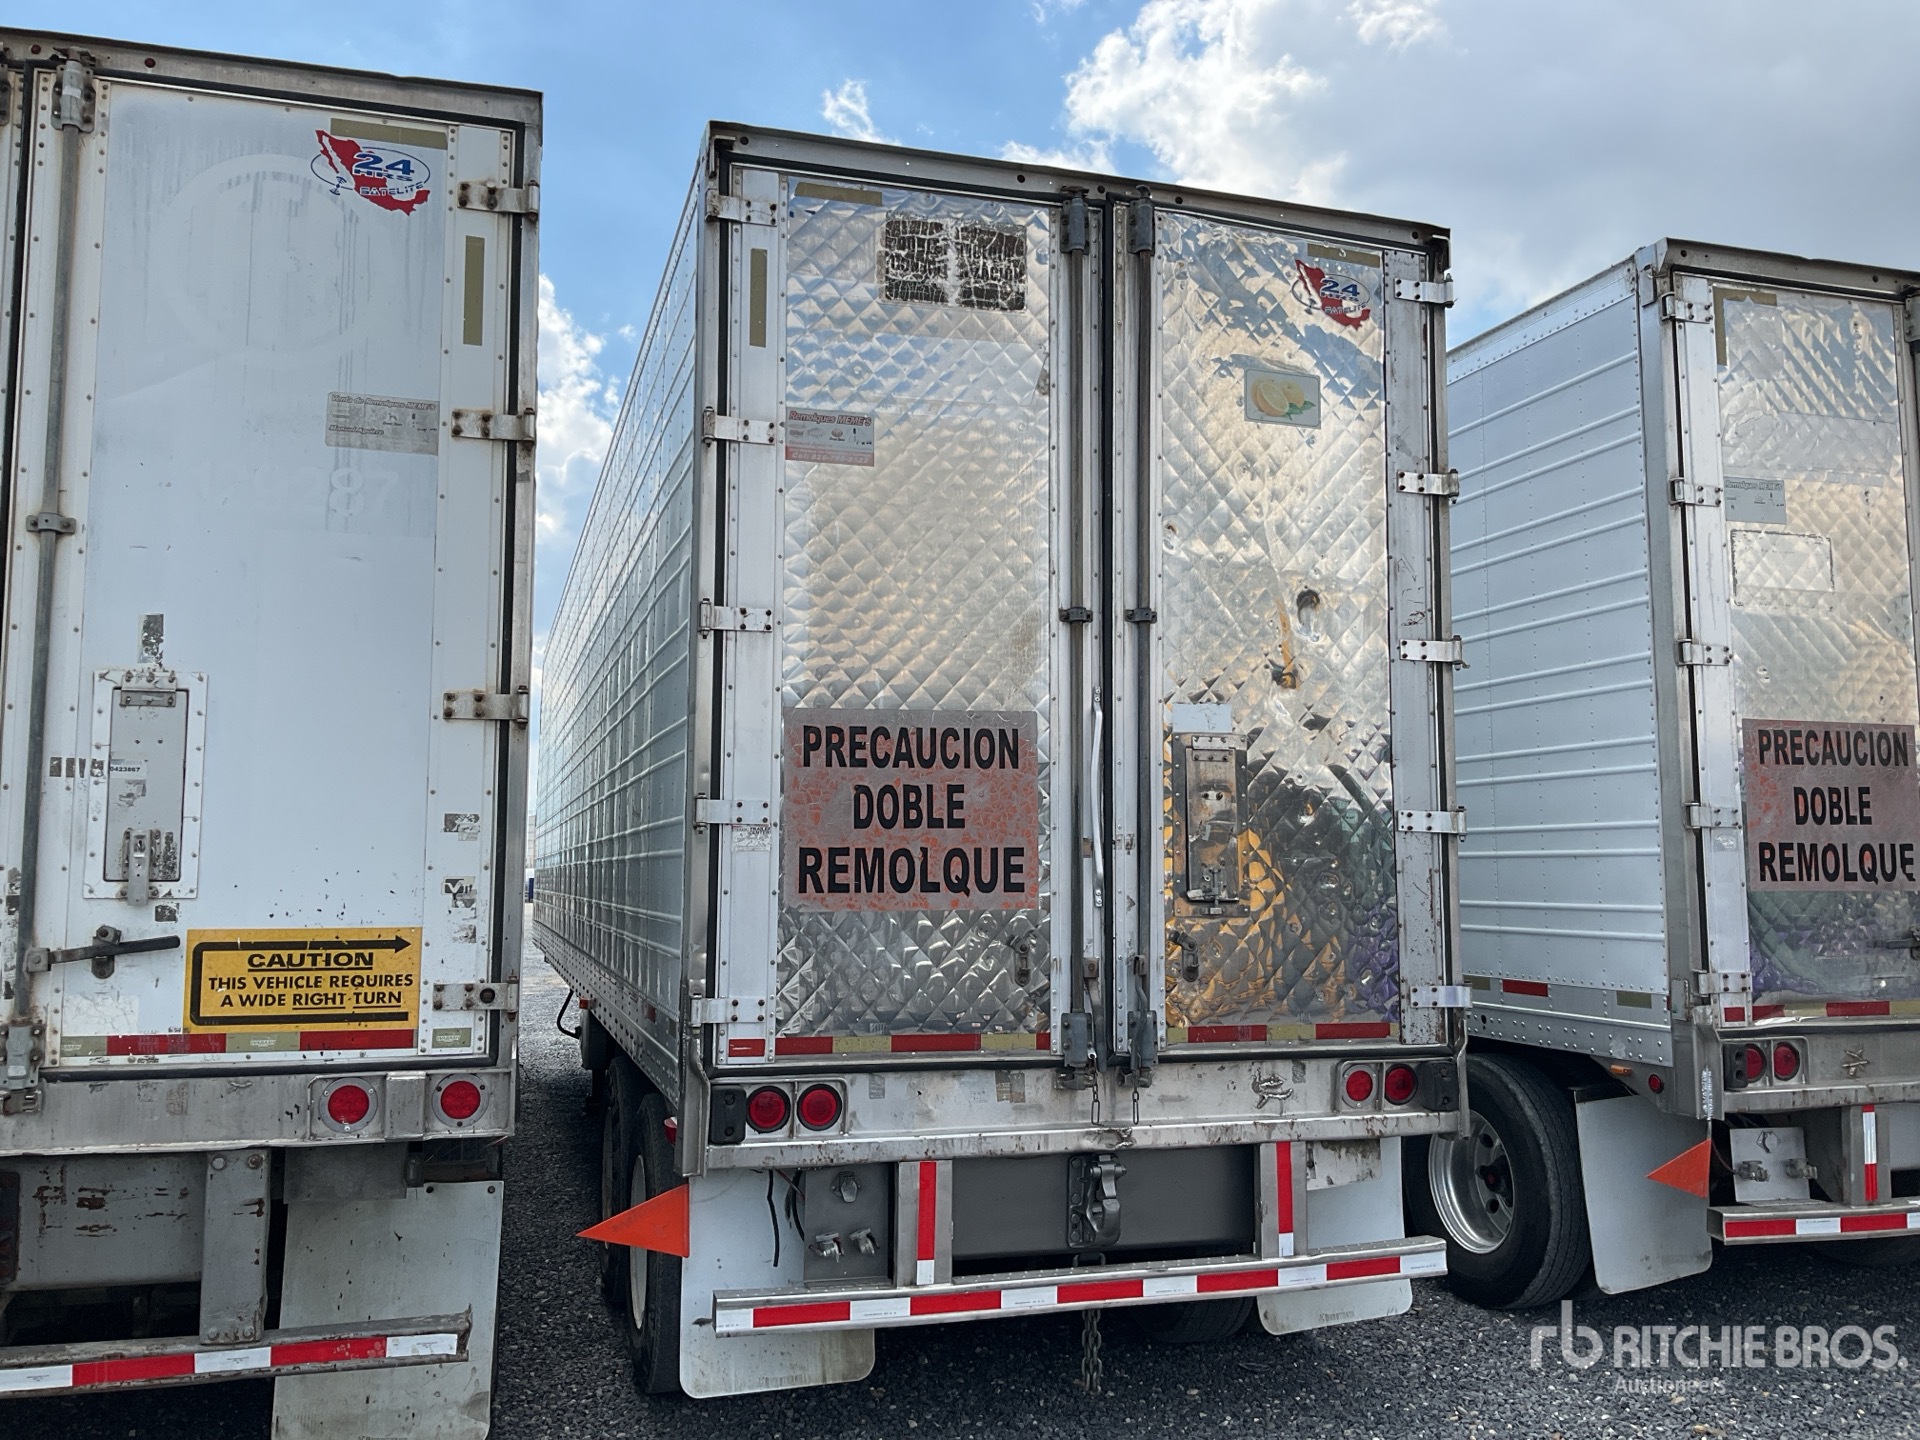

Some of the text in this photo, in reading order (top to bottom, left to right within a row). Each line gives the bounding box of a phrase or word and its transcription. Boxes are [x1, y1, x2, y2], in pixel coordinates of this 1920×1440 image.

[354, 152, 415, 176] 24
[353, 168, 413, 182] HRS
[359, 181, 424, 196] SATELITE
[1320, 279, 1360, 297] 24
[789, 411, 872, 426] Remolques MEME'S
[803, 725, 1019, 769] PRECAUCION
[1758, 729, 1909, 767] PRECAUCION
[853, 784, 966, 830] DOBLE
[1793, 786, 1873, 826] DOBLE
[798, 846, 1025, 897] REMOLQUE
[1758, 842, 1916, 885] REMOLQUE
[247, 952, 374, 968] CAUTION
[208, 974, 413, 990] THIS VEHICLE REQUIRES
[220, 991, 402, 1008] A WIDE RIGHT TURN
